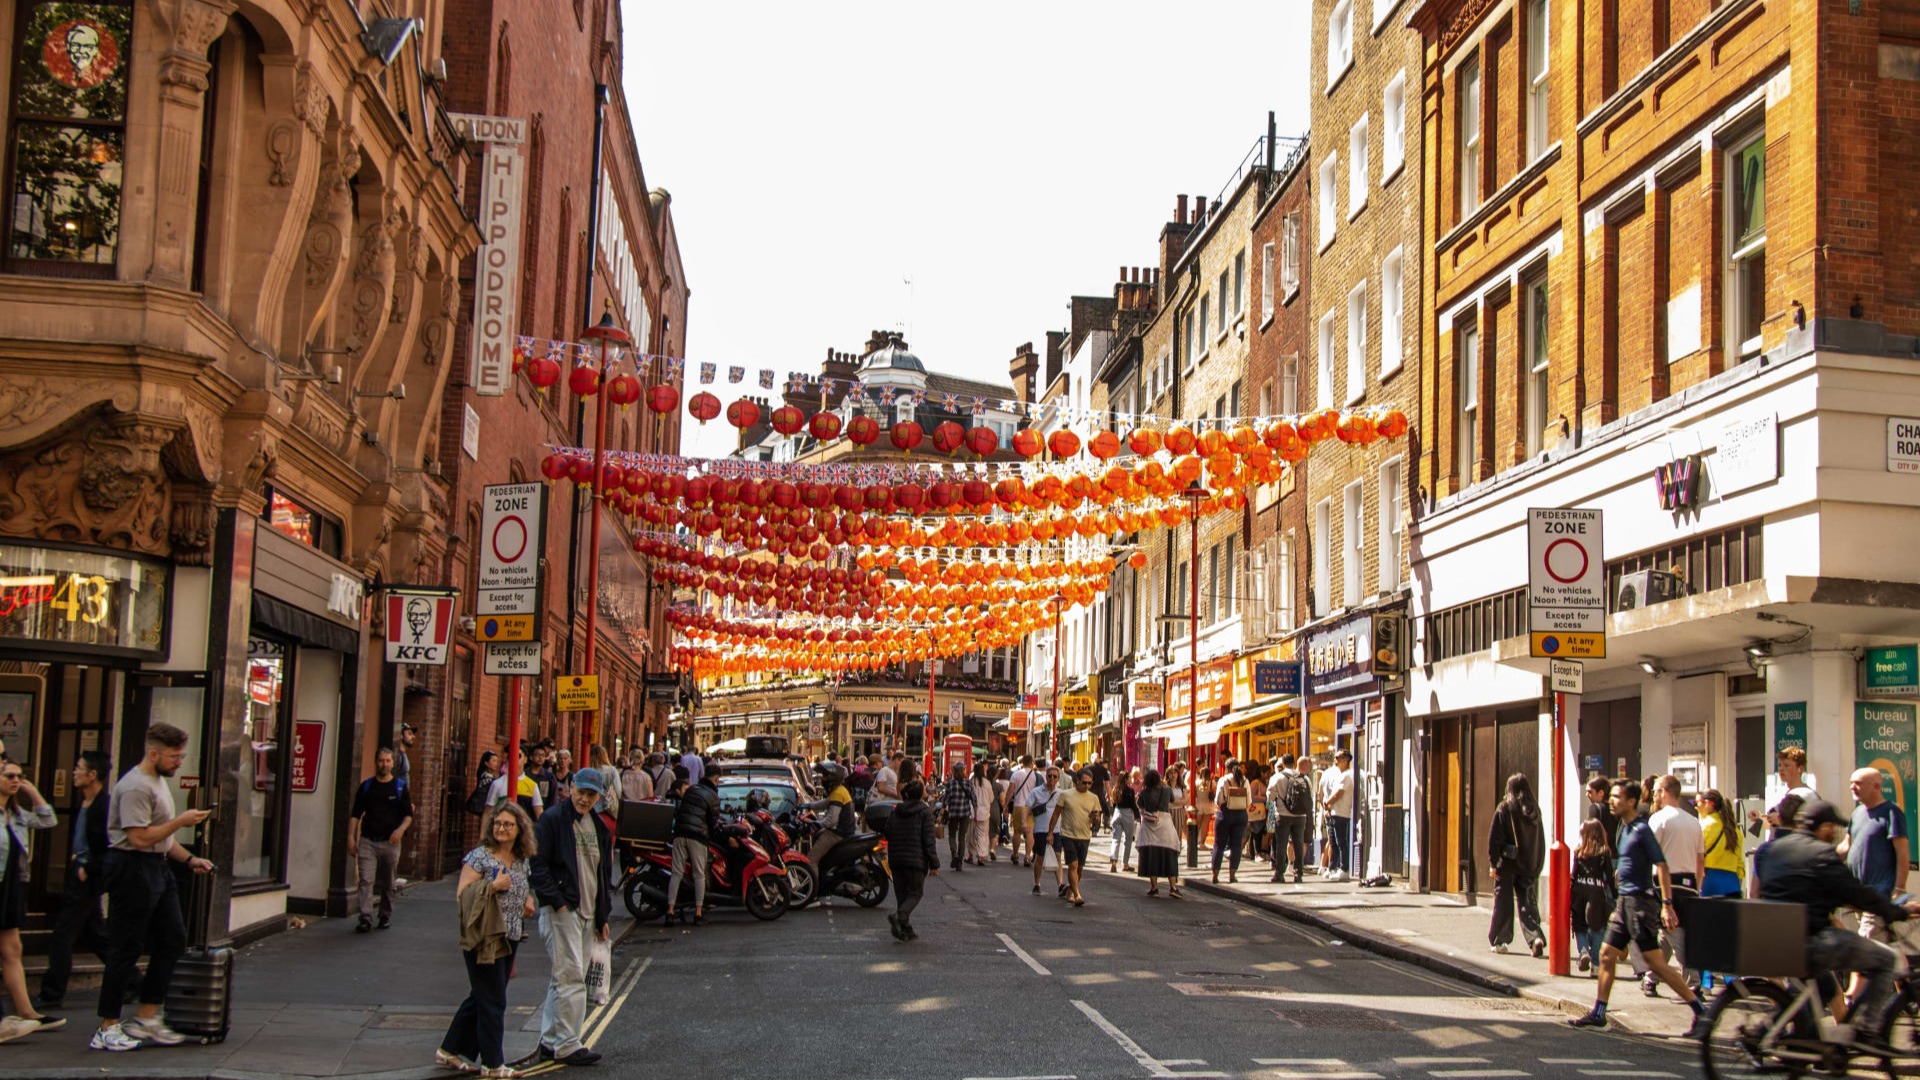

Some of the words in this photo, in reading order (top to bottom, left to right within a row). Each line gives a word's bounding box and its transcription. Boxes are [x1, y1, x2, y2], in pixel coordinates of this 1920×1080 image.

[455, 118, 519, 140] ODON
[481, 155, 512, 386] HIPPODROME
[490, 486, 536, 496] PEDESTRIAN
[495, 498, 528, 511] ZONE
[1536, 512, 1594, 520] PEDESTRIAN
[1544, 522, 1586, 534] ZONE
[501, 566, 528, 574] vehicles
[504, 576, 534, 586] Midnight
[50, 573, 108, 623] 43
[490, 594, 512, 602] Except
[514, 593, 524, 601] for
[1564, 596, 1600, 605] Midnight
[396, 646, 437, 660] KFC
[490, 646, 522, 657] Except
[524, 646, 538, 656] for
[498, 660, 528, 668] access
[1876, 662, 1892, 672] free
[1893, 661, 1907, 671] cash
[1554, 664, 1572, 676] Except
[1559, 679, 1576, 688] access
[1778, 710, 1802, 720] bureau
[1864, 707, 1907, 721] bureau
[856, 714, 878, 730] KU
[1786, 724, 1795, 735] de
[1878, 724, 1894, 736] de
[1864, 738, 1909, 754] change
